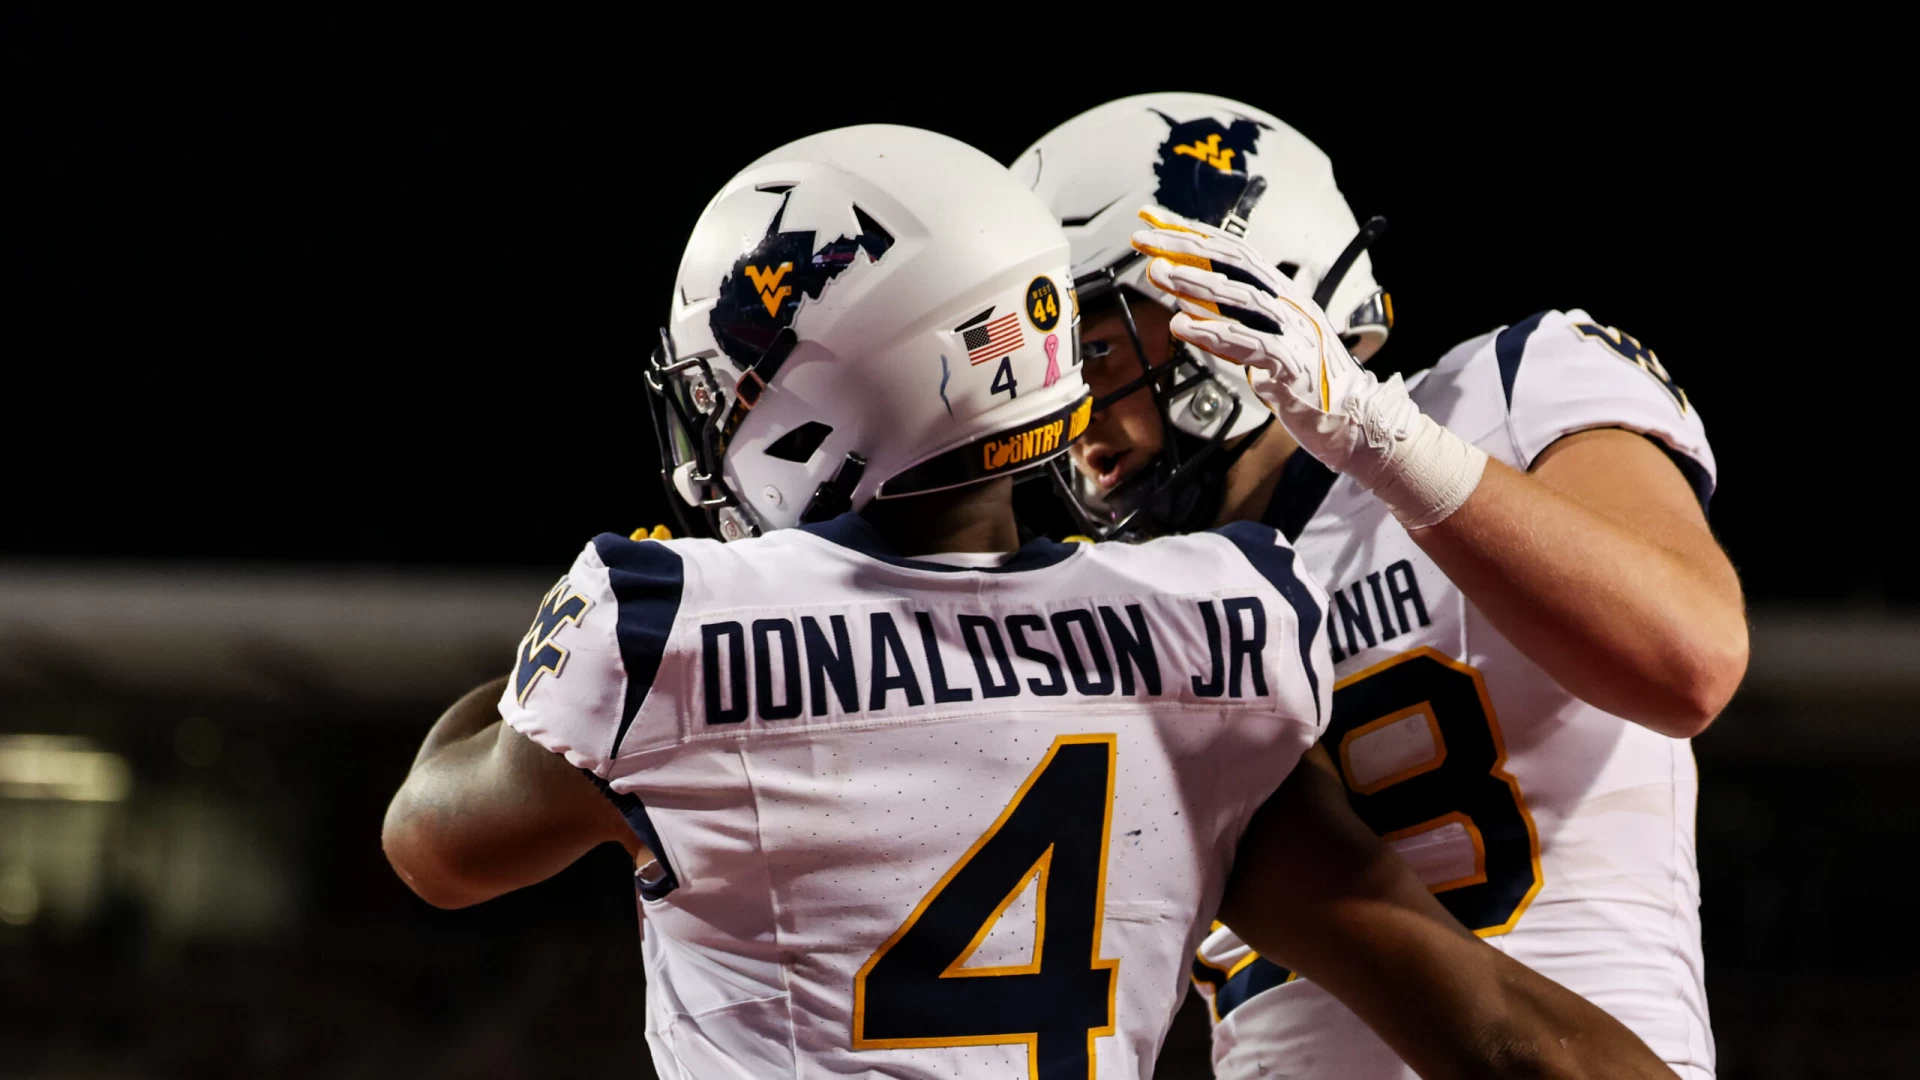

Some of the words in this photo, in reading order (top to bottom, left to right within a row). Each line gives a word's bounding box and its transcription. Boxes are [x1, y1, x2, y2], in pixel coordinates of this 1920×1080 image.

[1031, 284, 1052, 299] WEST
[1033, 293, 1057, 322] 44
[990, 355, 1017, 400] 4
[700, 603, 1163, 725] DONALDSON
[1190, 596, 1269, 698] JR
[851, 732, 1121, 1080] 4
